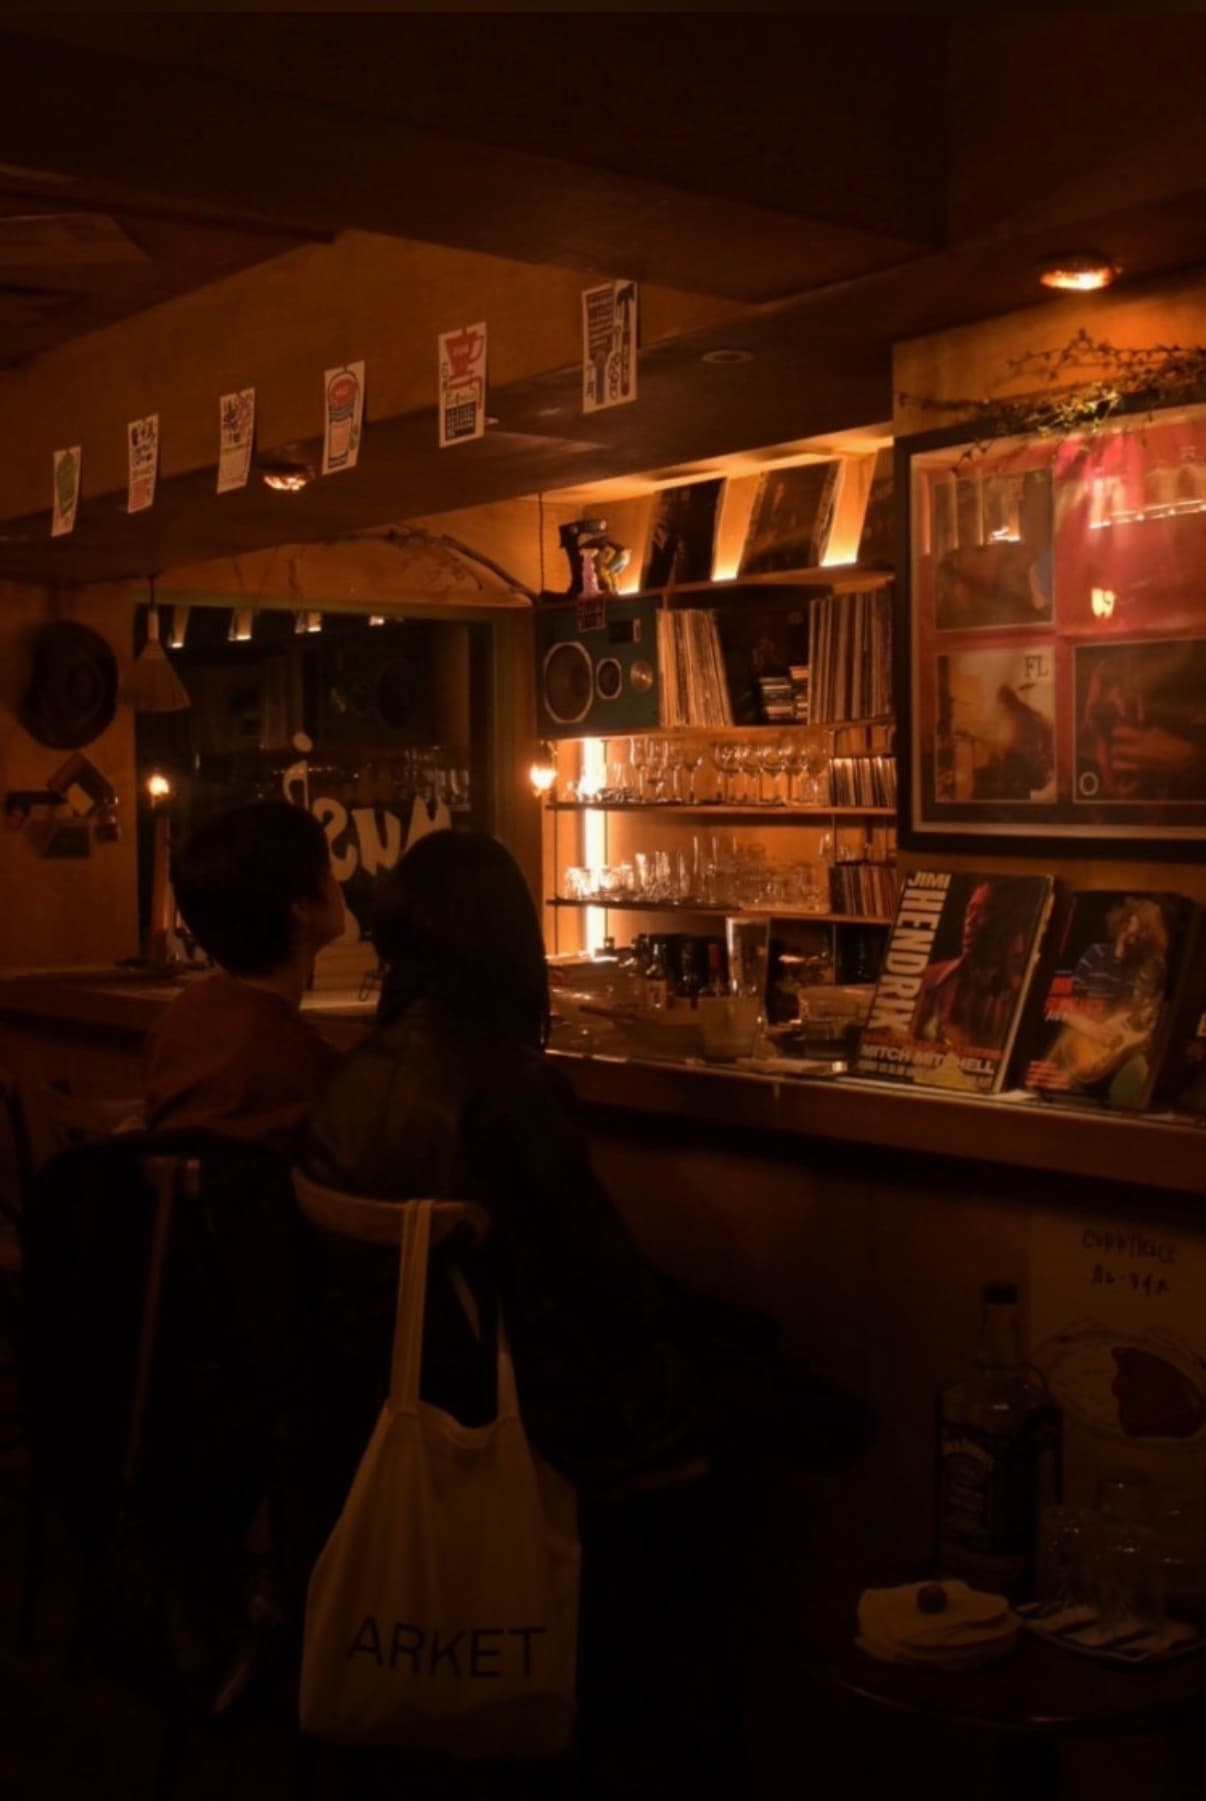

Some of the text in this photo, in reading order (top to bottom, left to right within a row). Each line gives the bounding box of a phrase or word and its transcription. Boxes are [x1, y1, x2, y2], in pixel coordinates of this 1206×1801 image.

[907, 870, 951, 890] JIMI
[868, 889, 948, 1034] HENDRIX
[345, 1617, 547, 1678] ARKET
